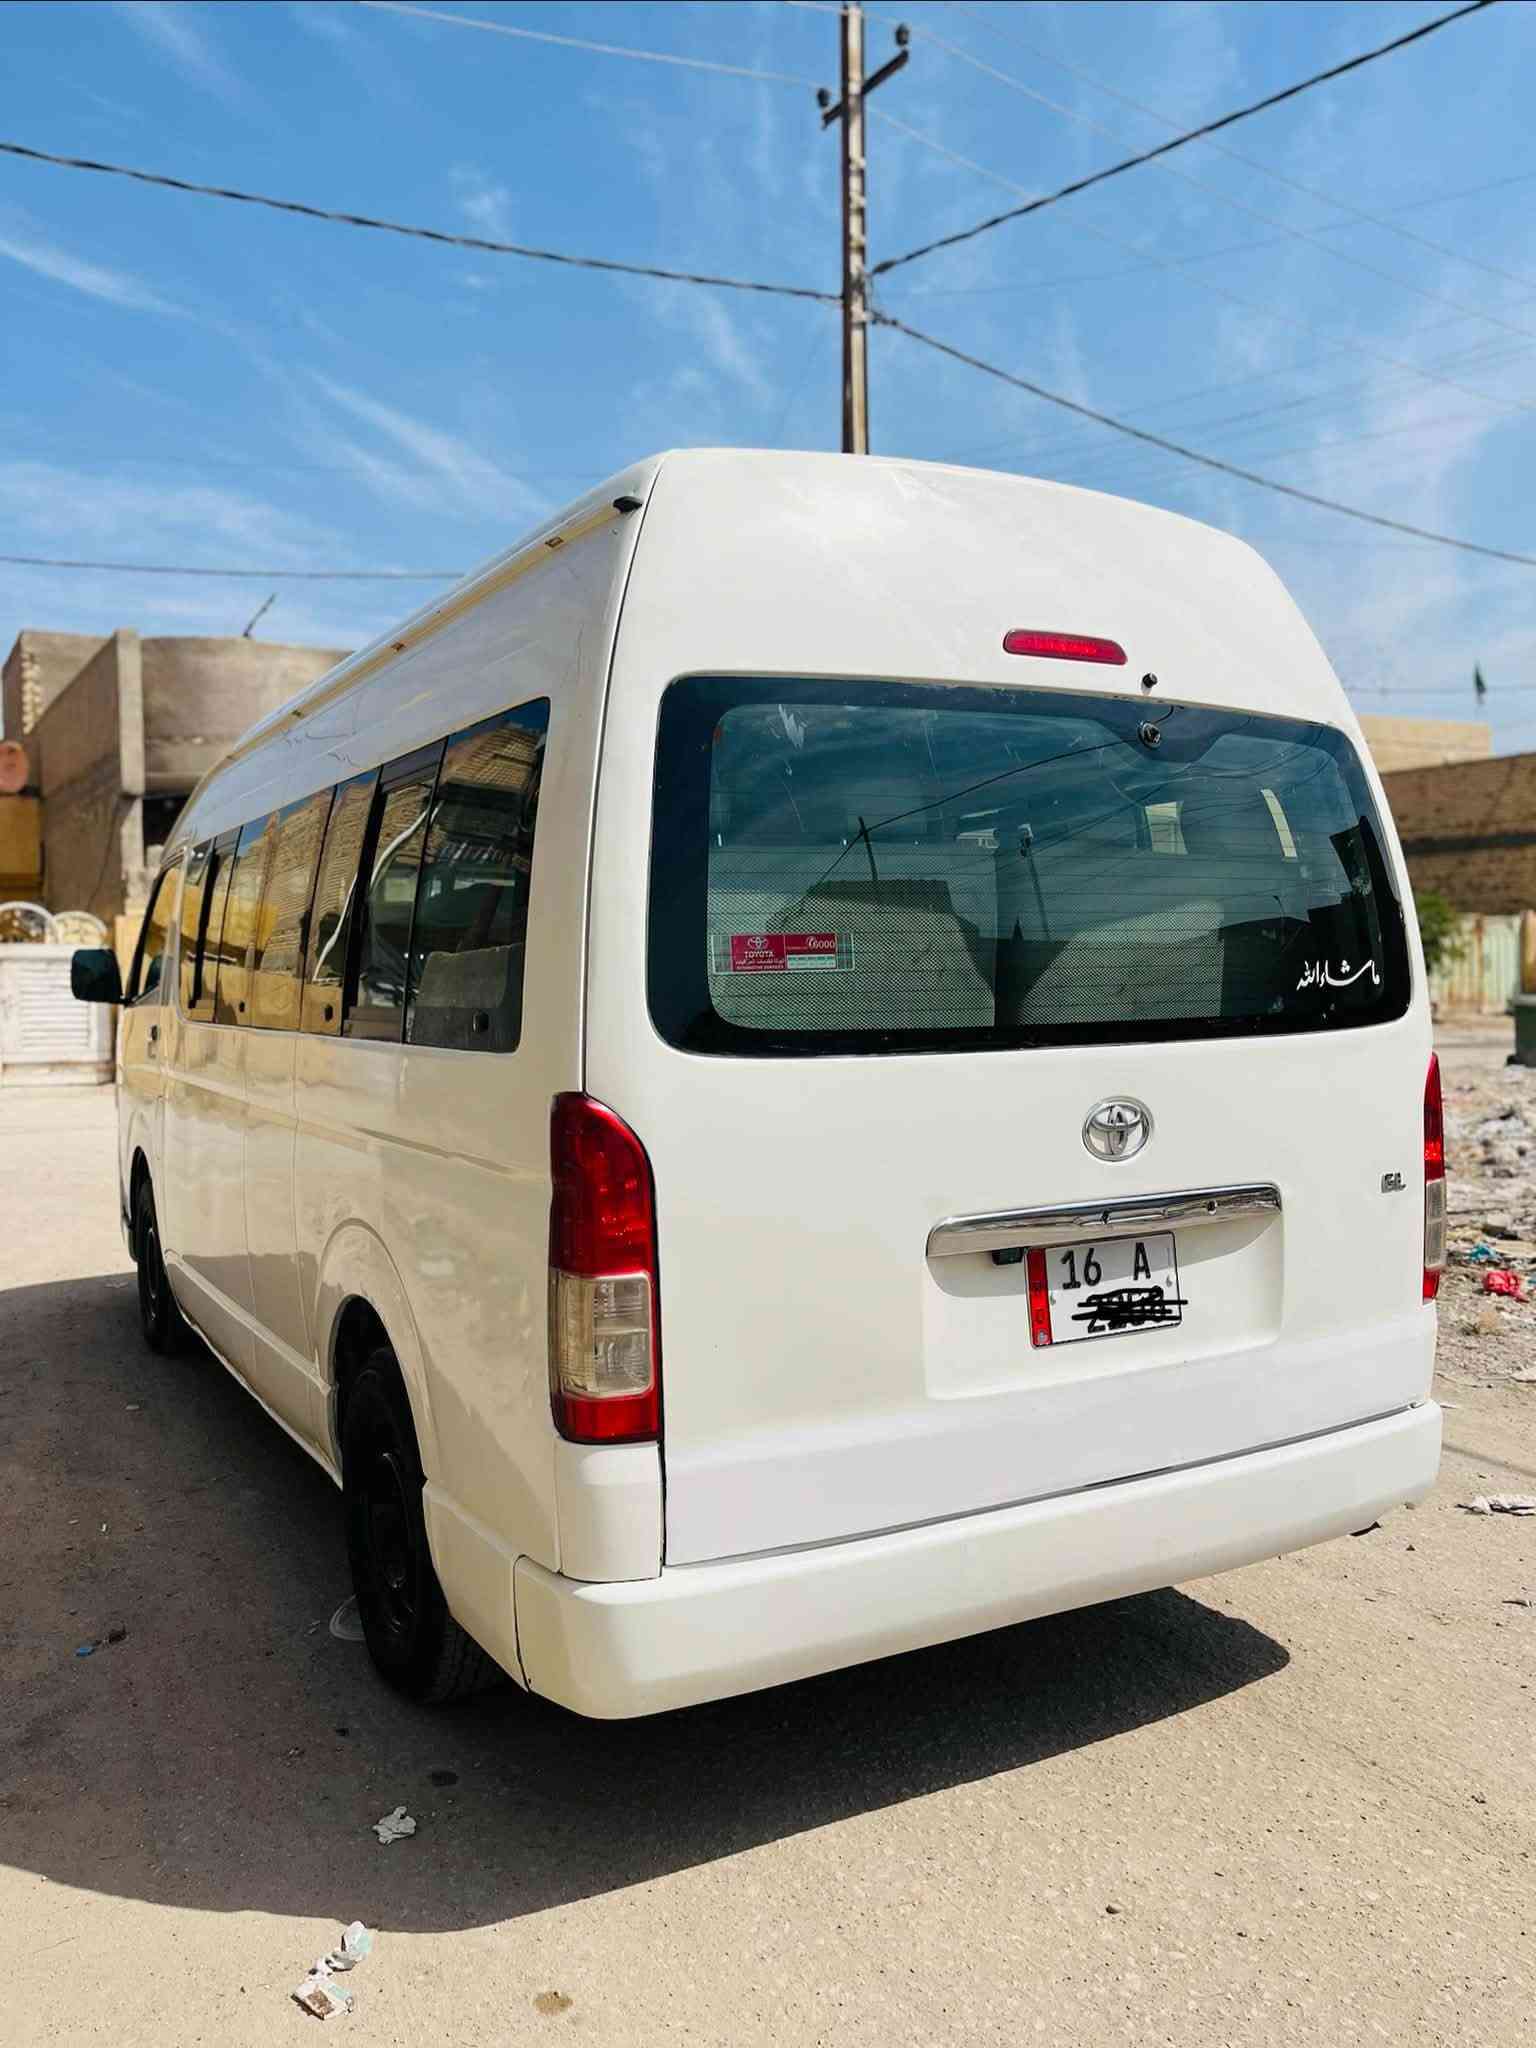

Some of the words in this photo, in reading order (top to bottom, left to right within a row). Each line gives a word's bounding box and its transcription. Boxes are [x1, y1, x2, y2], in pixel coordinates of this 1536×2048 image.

[744, 950, 774, 959] TOYOTA
[1060, 1247, 1103, 1290] 16
[1133, 1242, 1152, 1281] A
